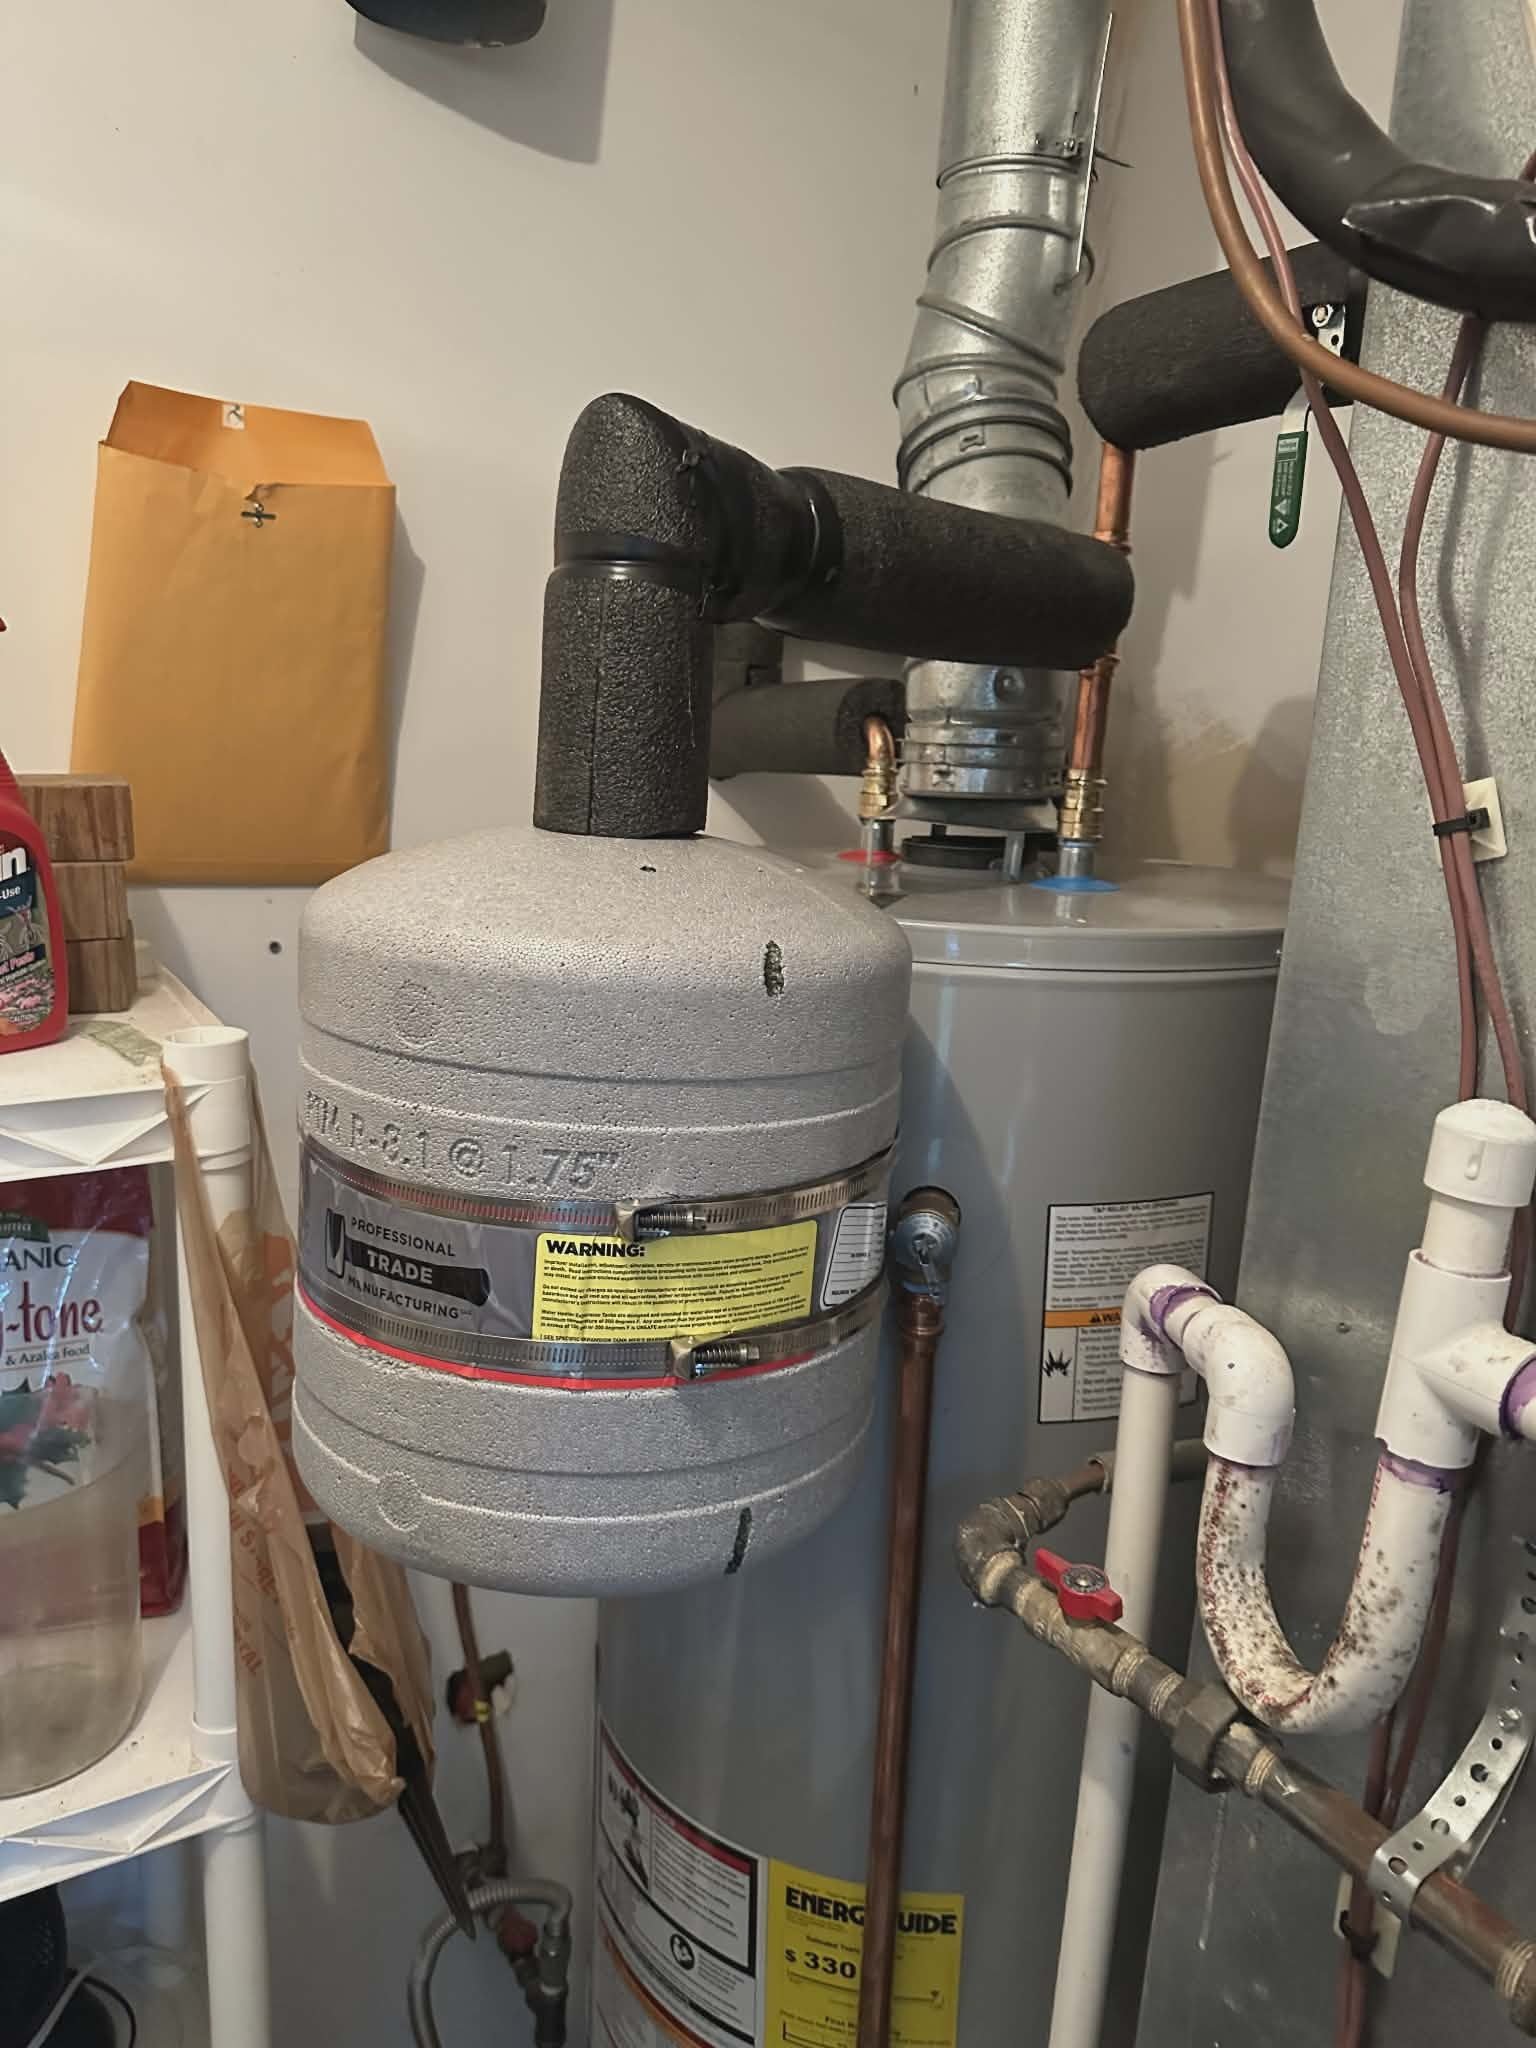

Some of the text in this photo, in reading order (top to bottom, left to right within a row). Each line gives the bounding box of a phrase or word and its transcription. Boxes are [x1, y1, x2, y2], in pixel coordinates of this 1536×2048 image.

[0, 847, 27, 882] n
[449, 1137, 490, 1179] @
[352, 1216, 456, 1257] PROFESSIONAL
[546, 1240, 645, 1257] WARNING:
[367, 1250, 433, 1285] TRADE
[0, 1280, 103, 1344] -tone
[348, 1274, 459, 1320] MANUFACTURING
[6, 1354, 16, 1366] &
[19, 1349, 60, 1364] Azala
[785, 1886, 957, 1935] ENERGUIDE
[804, 1951, 857, 1980] 330
